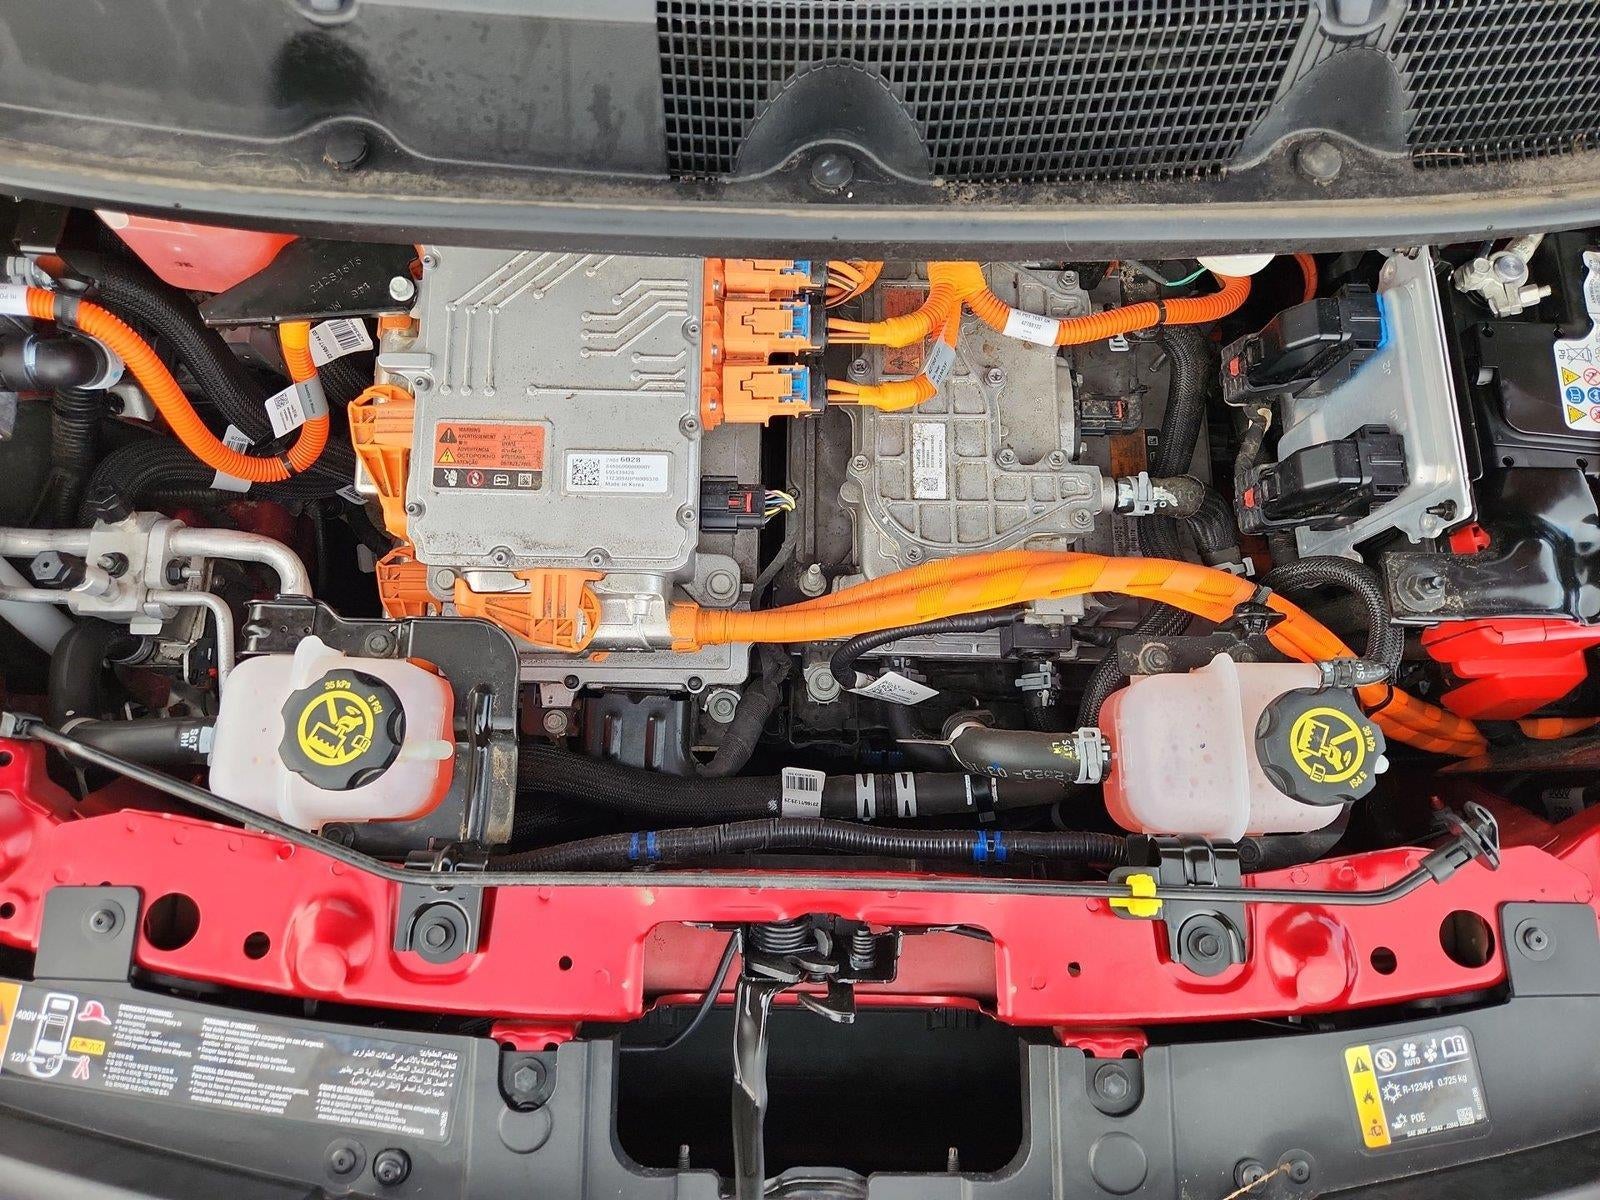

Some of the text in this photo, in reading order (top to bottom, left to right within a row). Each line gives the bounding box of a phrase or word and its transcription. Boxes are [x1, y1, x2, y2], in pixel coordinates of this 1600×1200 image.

[1558, 349, 1566, 360] Pb
[325, 680, 351, 690] 35 kPa
[371, 701, 384, 715] PSI
[180, 732, 189, 747] RH
[189, 728, 199, 751] SGT
[1361, 725, 1376, 752] 35 kPa
[1349, 771, 1367, 789] 5 PSI
[11, 1052, 27, 1063] 12V
[1404, 1057, 1421, 1067] AUTO
[1402, 1074, 1468, 1094] R-1234yf 0.725 kg
[1410, 1112, 1427, 1123] POE
